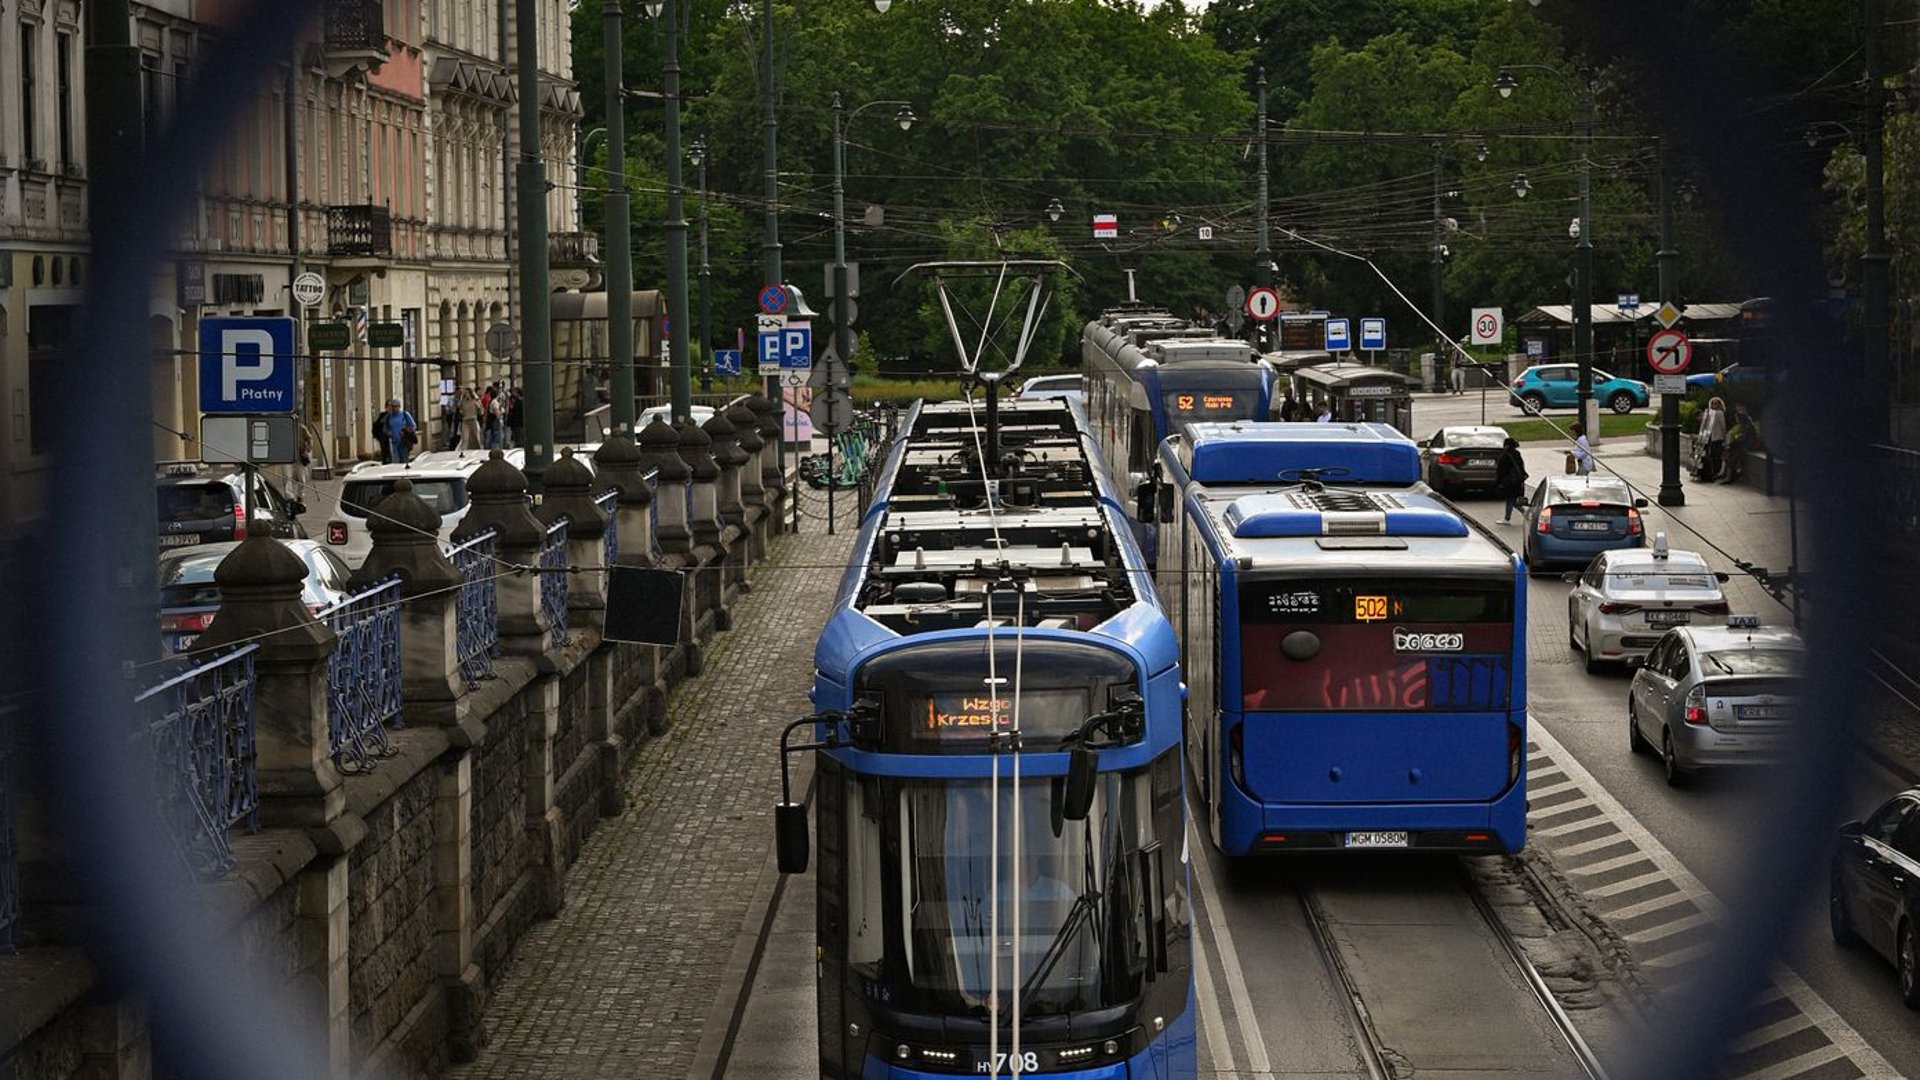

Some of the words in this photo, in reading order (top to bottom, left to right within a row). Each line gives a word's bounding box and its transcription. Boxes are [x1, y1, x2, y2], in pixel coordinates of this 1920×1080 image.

[1200, 228, 1211, 238] 10
[295, 284, 323, 293] TATTOO
[1479, 320, 1495, 332] 30
[786, 332, 804, 357] P
[222, 329, 274, 401] P
[241, 388, 284, 402] Płatny
[1178, 396, 1194, 409] 52
[169, 466, 192, 474] TAXI
[1357, 598, 1386, 617] 502
[1732, 616, 1758, 625] TAXI
